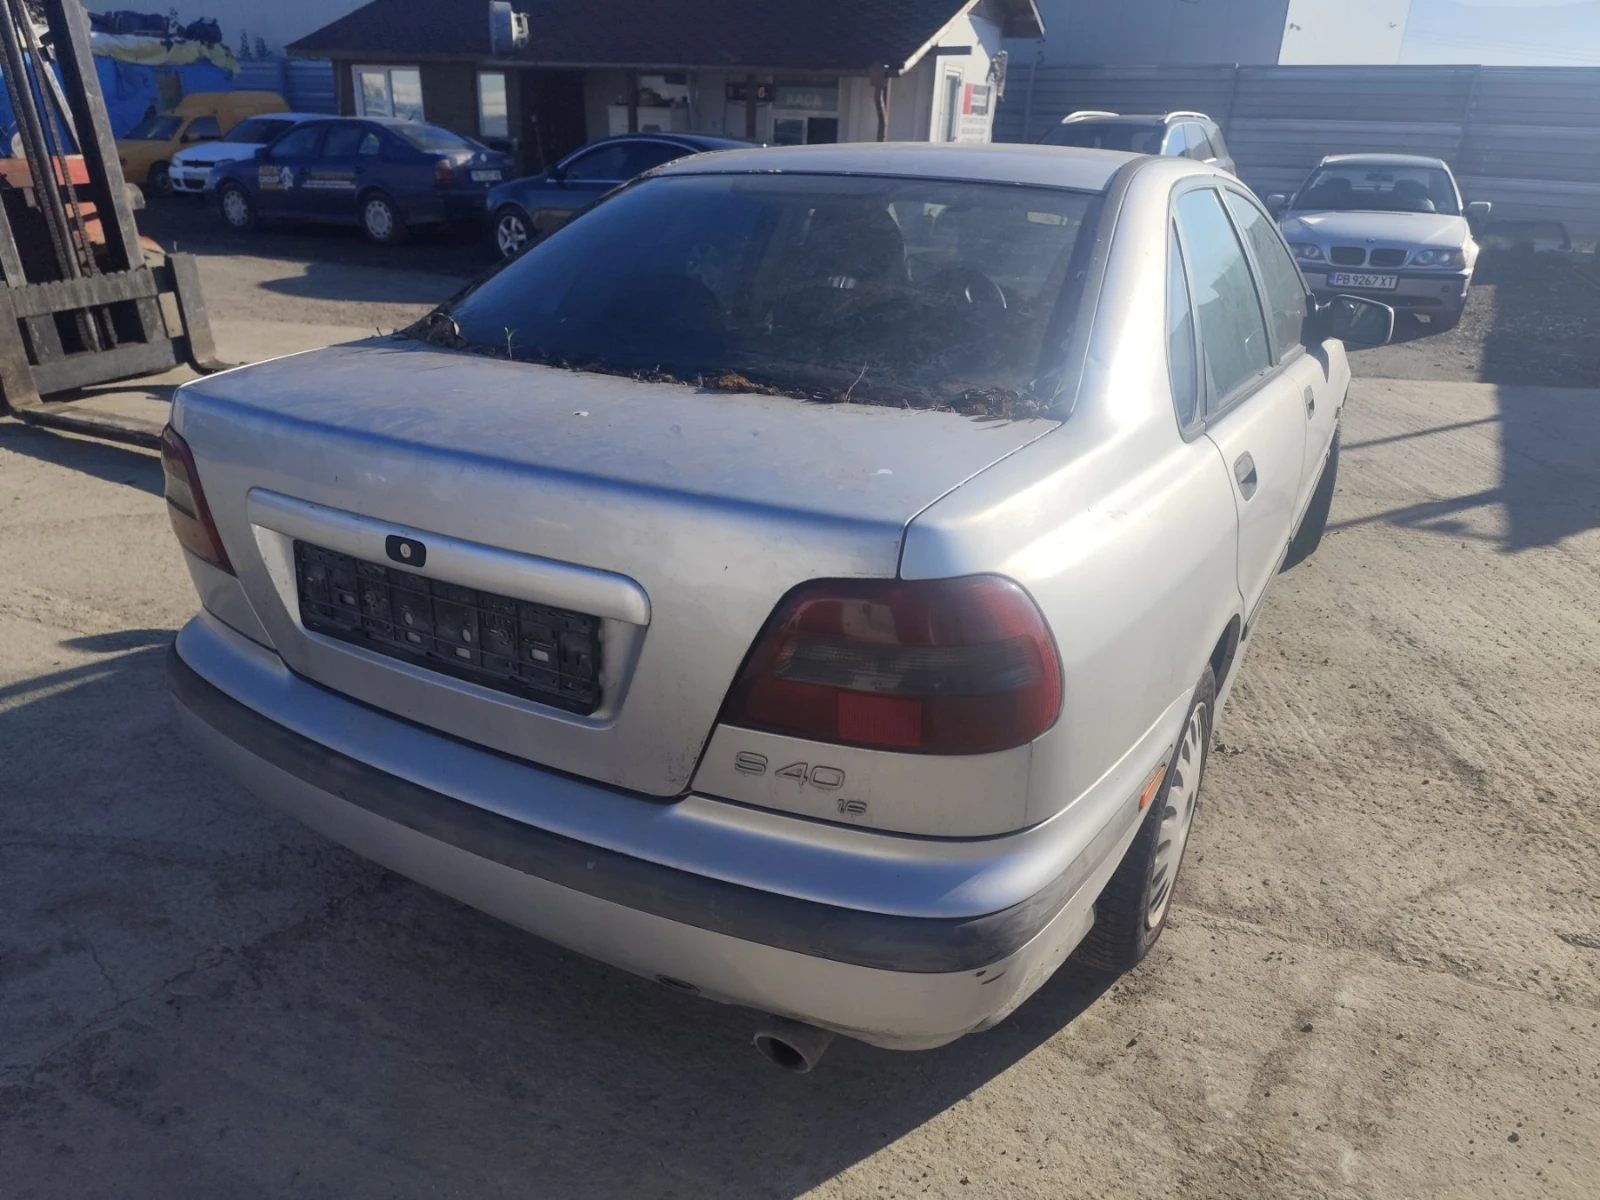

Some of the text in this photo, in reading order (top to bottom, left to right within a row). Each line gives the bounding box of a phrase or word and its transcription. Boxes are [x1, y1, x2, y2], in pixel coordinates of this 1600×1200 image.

[1336, 273, 1395, 287] PB 9267 XT
[775, 762, 845, 791] 40
